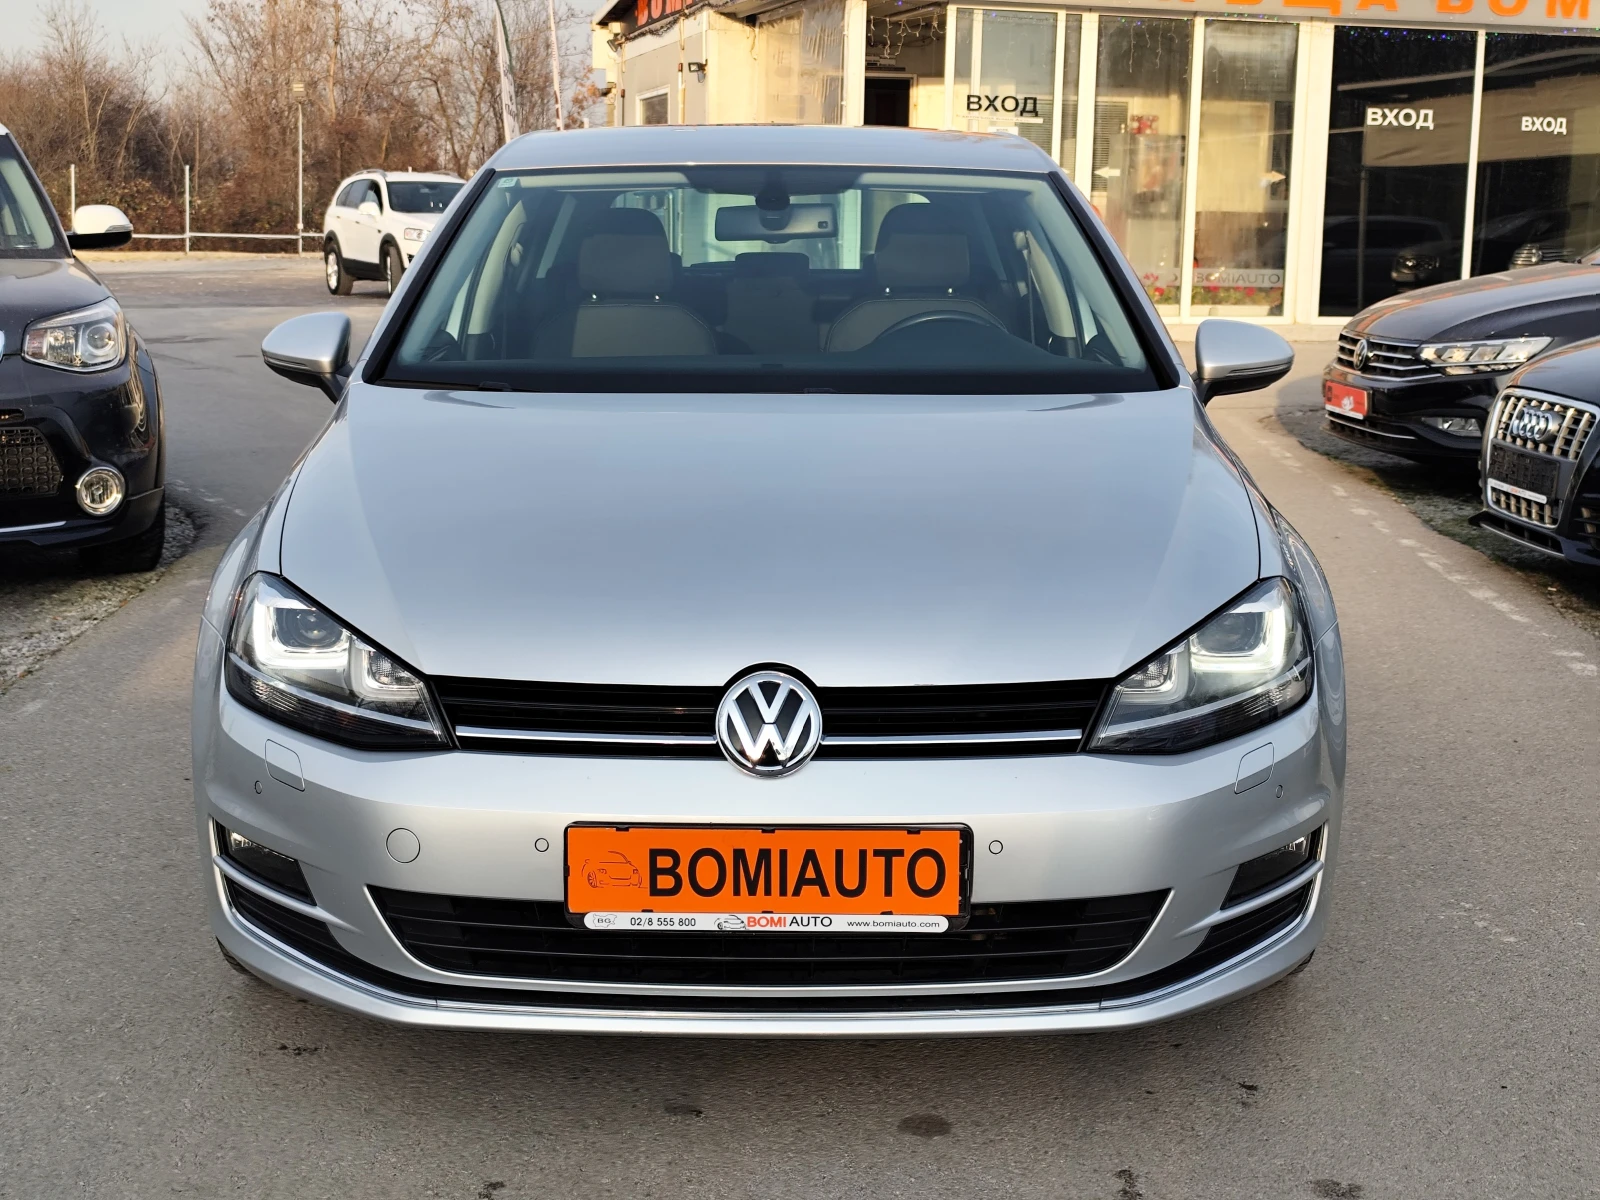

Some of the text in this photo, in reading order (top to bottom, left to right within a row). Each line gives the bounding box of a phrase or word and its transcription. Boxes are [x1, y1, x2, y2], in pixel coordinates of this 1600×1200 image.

[966, 94, 1039, 117] ВХОД
[1366, 107, 1434, 130] ВХОД
[1521, 116, 1567, 135] ВХОД
[648, 847, 947, 898] BOMIAUTO
[630, 917, 696, 927] 02/8 555 800
[747, 916, 833, 928] BOMI AUTO
[847, 920, 940, 928] www.bomiauto.com
